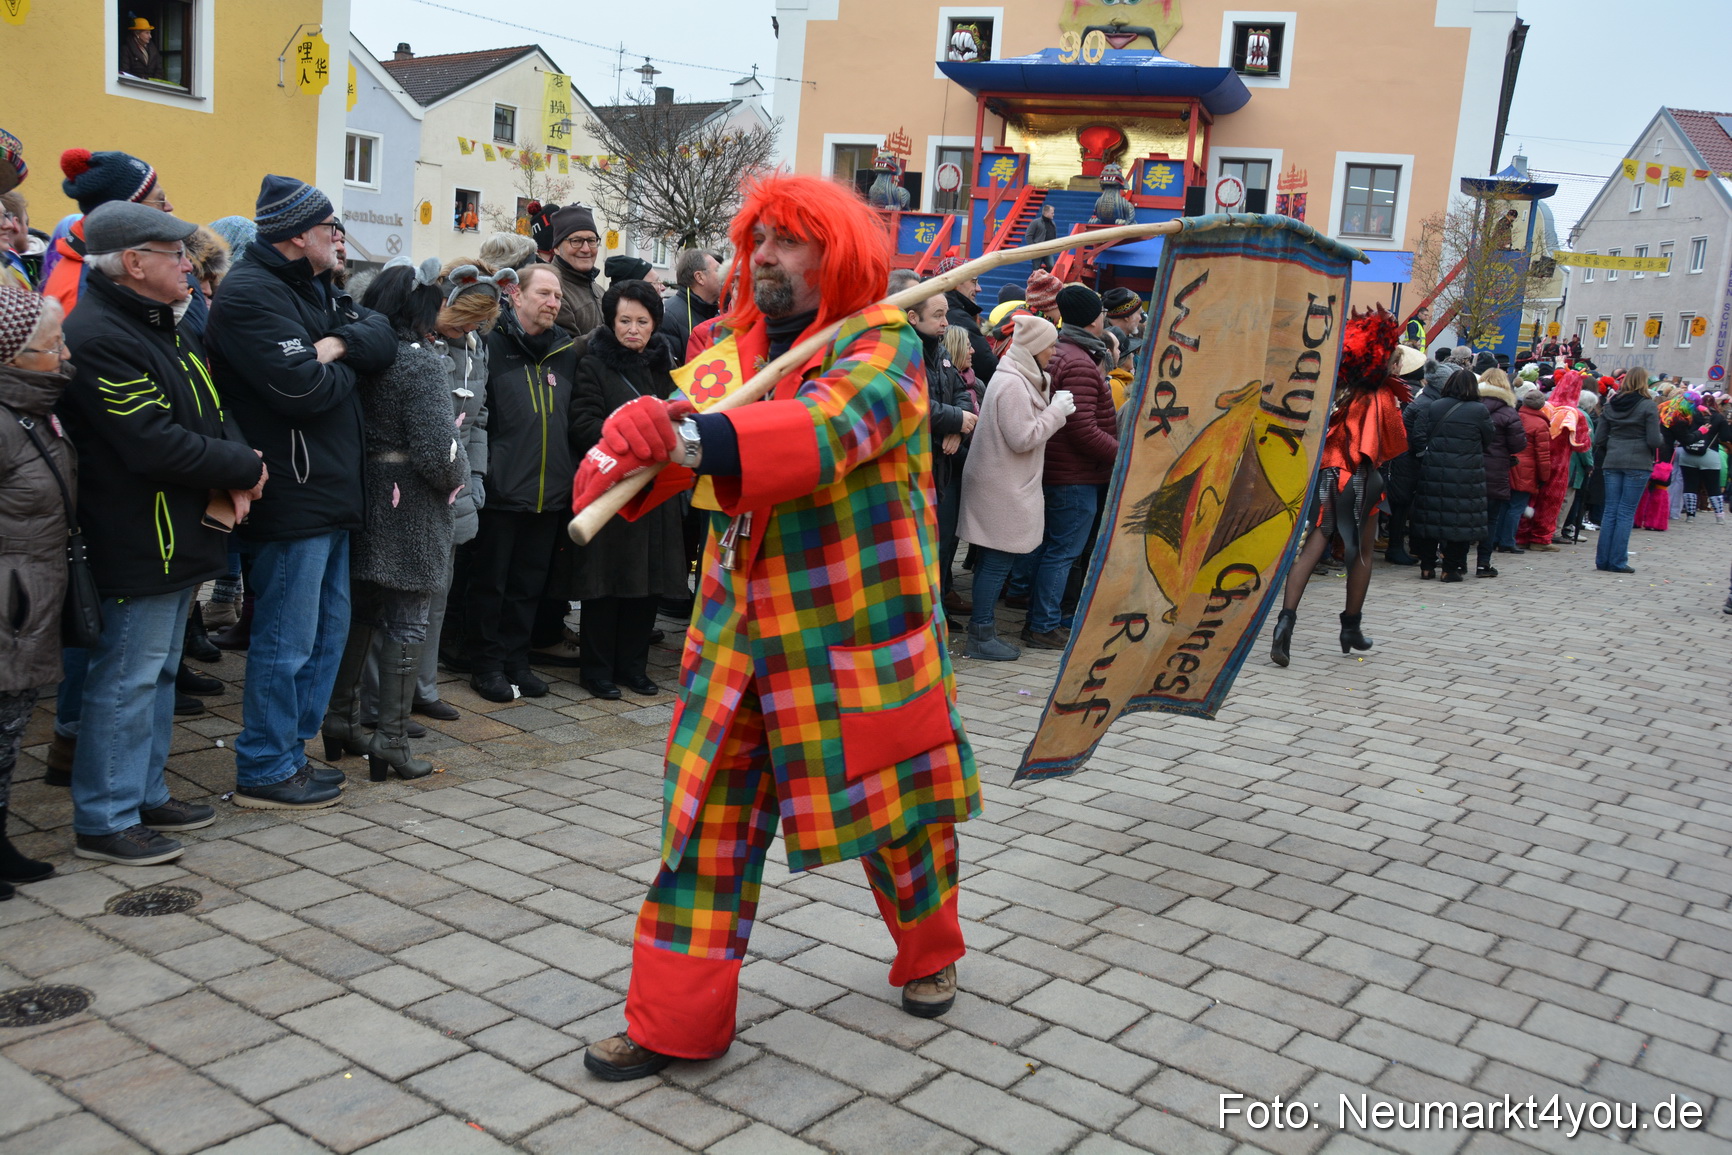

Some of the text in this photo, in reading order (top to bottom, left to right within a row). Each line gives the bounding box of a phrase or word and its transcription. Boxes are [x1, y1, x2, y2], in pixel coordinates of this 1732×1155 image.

[1058, 30, 1106, 64] 90
[1715, 302, 1731, 365] SCHMUCK
[1053, 268, 1210, 728] Weck Ruf
